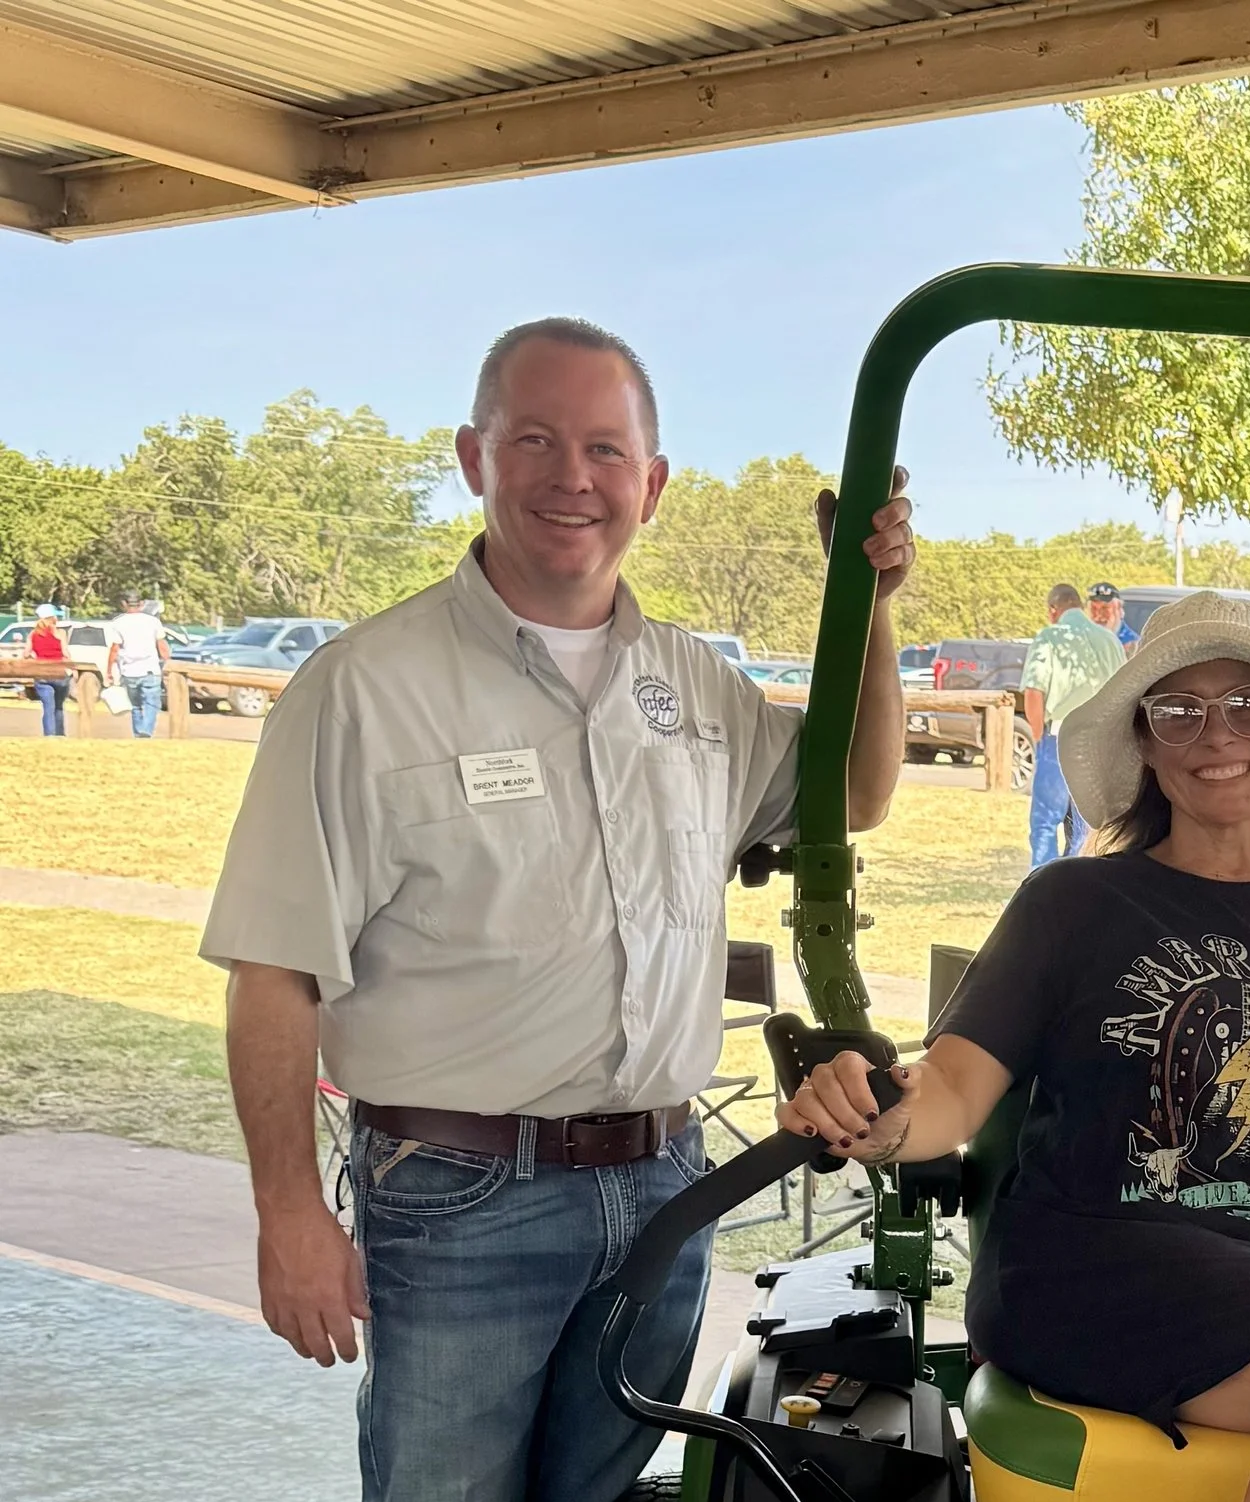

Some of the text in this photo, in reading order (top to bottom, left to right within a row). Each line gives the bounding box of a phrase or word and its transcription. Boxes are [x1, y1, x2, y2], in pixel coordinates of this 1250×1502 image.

[642, 688, 676, 720] nfec
[473, 777, 535, 791] BRENT MEADOR
